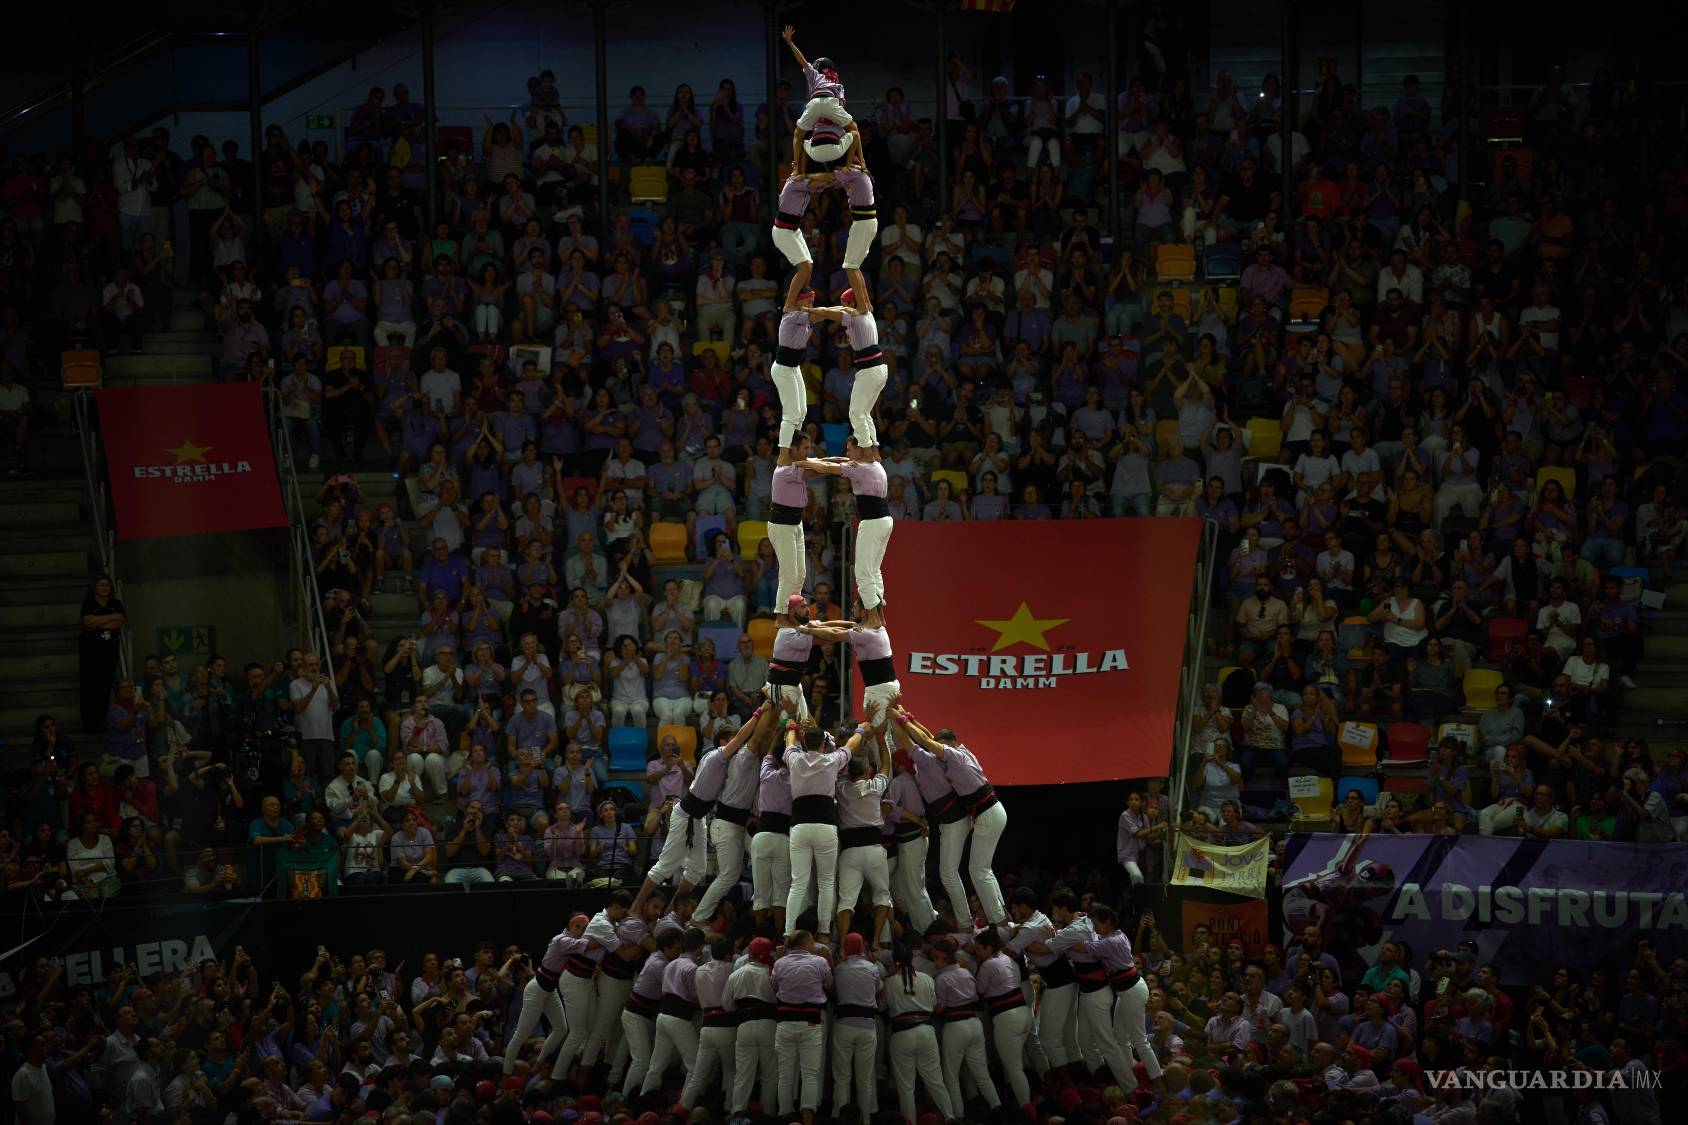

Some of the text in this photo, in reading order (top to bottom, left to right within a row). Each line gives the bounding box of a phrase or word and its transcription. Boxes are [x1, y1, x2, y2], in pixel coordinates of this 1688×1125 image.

[132, 461, 252, 478] ESTRELLA
[174, 475, 216, 483] DAMM
[909, 649, 1129, 676] ESTRELLA
[979, 677, 1057, 689] DAMM
[1391, 882, 1688, 930] A DISFRUTA
[1209, 917, 1244, 932] PUNT
